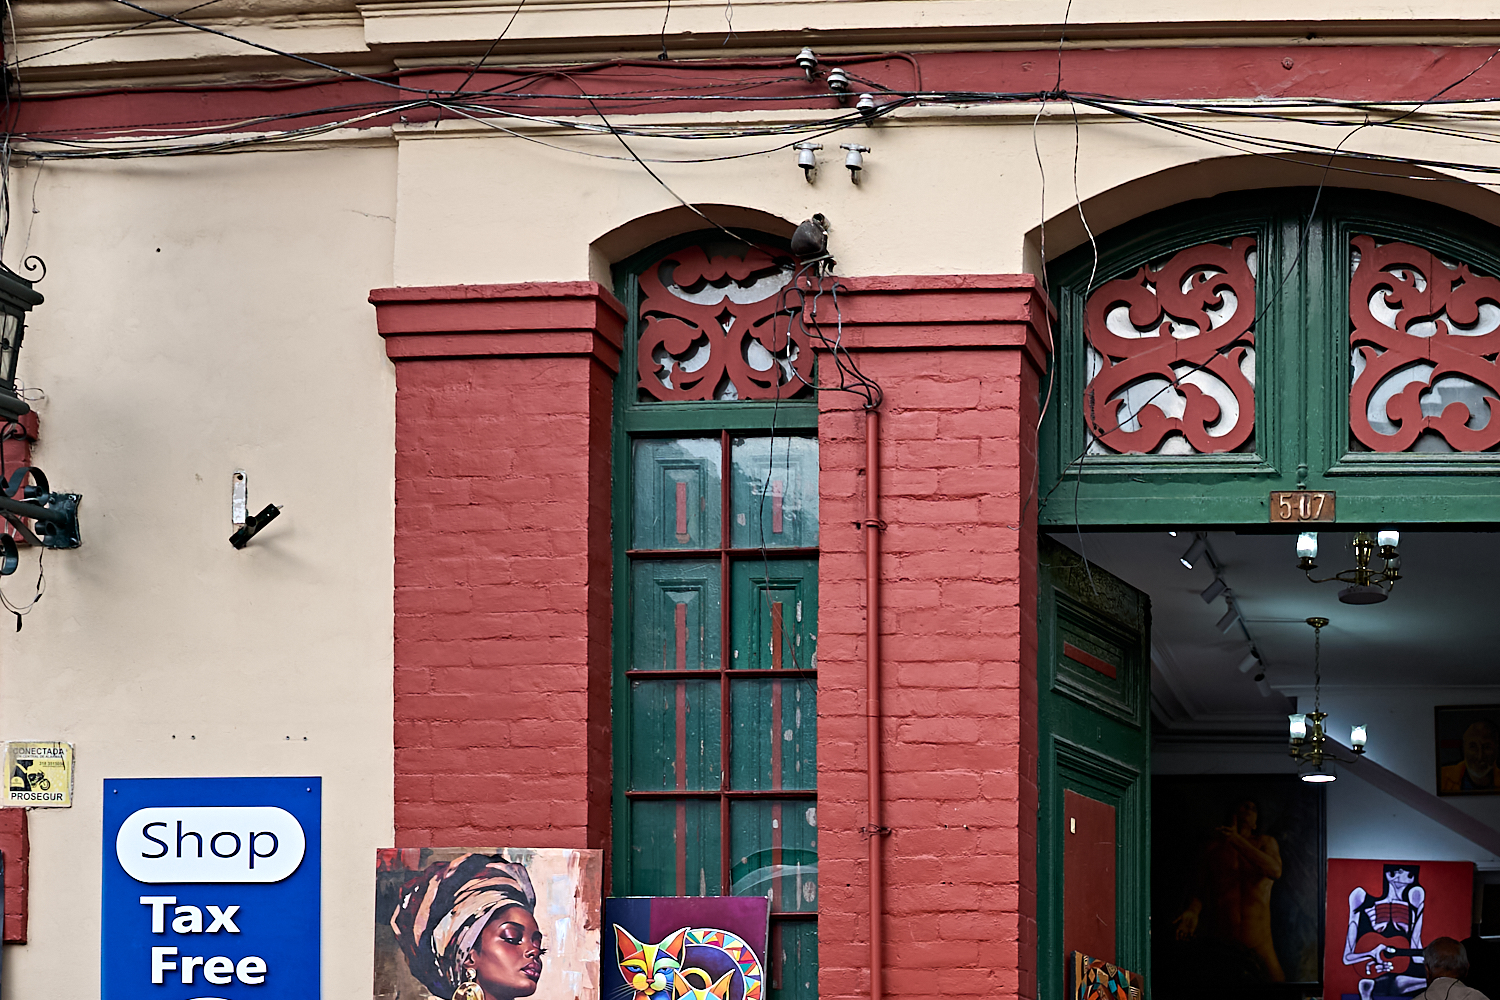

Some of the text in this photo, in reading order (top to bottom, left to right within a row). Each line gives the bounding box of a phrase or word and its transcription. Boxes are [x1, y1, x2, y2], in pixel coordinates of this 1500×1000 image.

[1279, 493, 1325, 520] 5-07
[11, 792, 63, 801] PROSEGUR
[141, 820, 279, 869] Shop
[139, 895, 241, 934] Tax
[151, 946, 268, 985] Free
